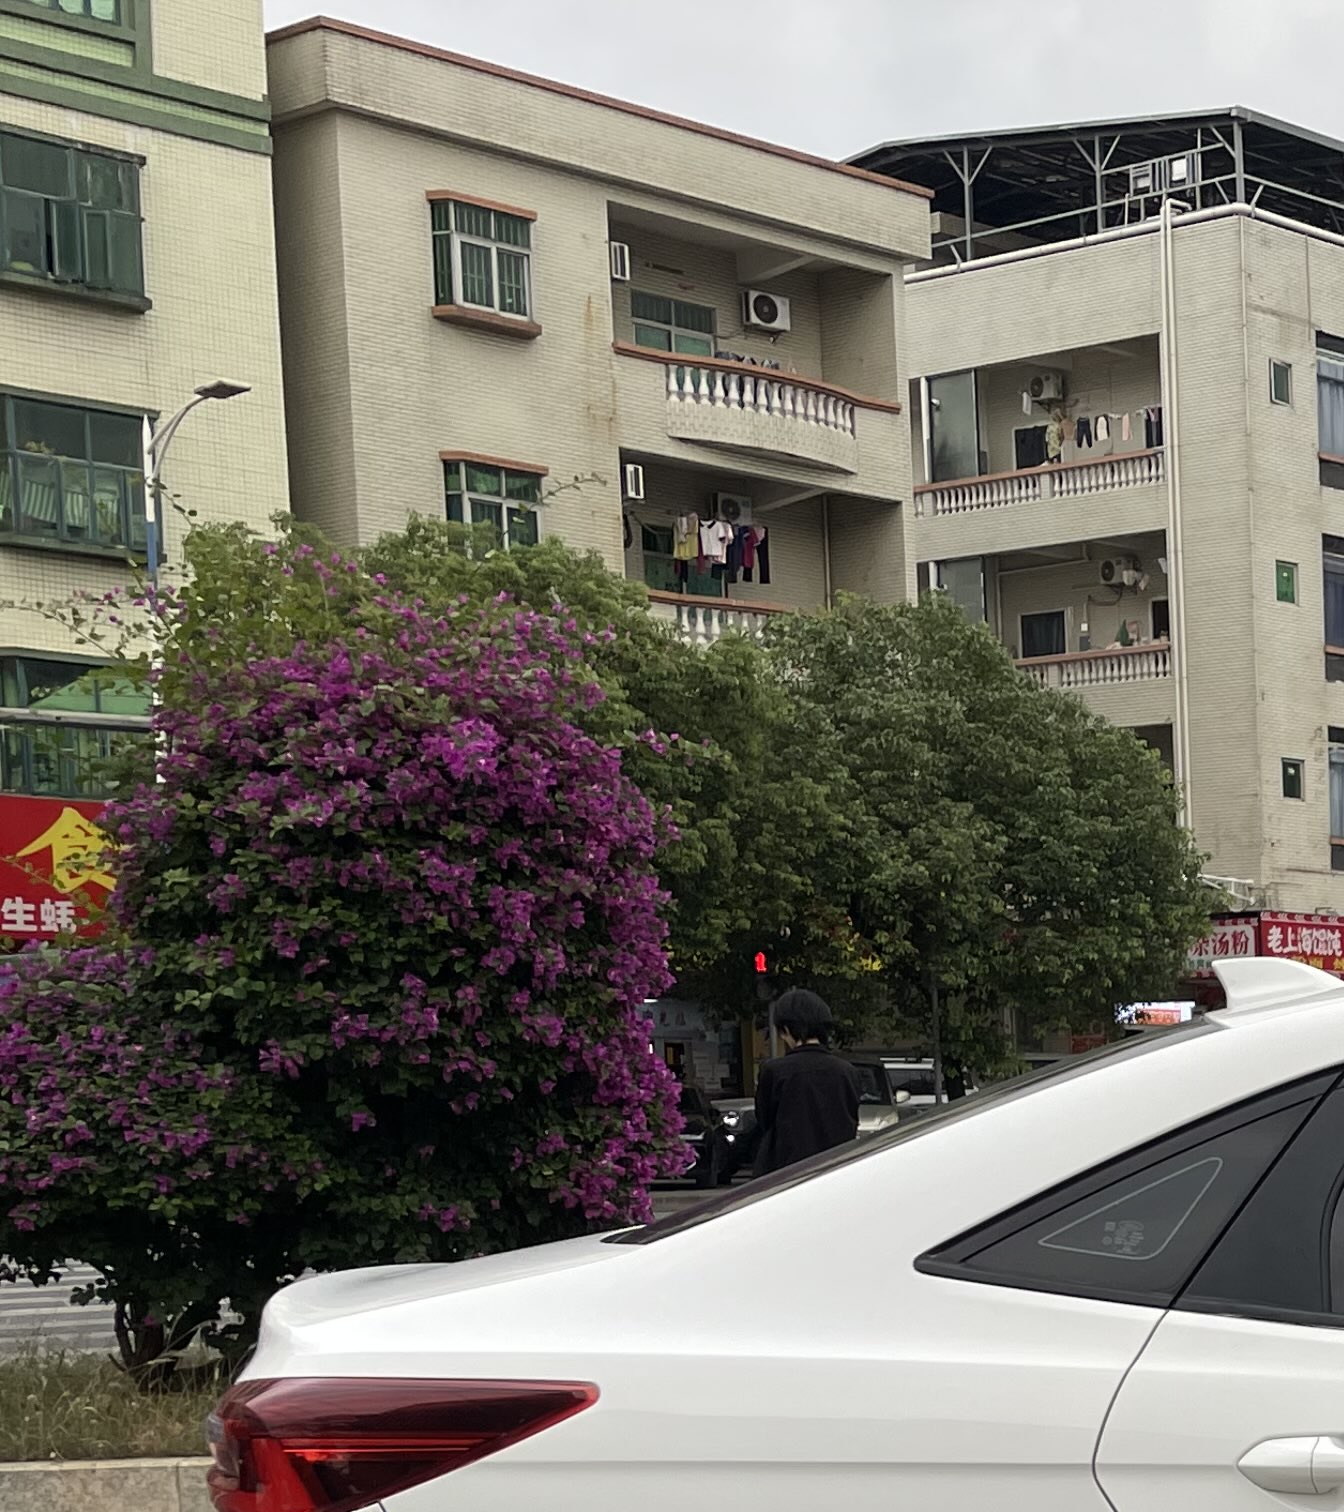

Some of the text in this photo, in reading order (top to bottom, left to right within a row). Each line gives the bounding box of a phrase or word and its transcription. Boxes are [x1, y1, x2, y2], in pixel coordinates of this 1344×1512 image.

[1267, 925, 1343, 957] 老上海馄饨
